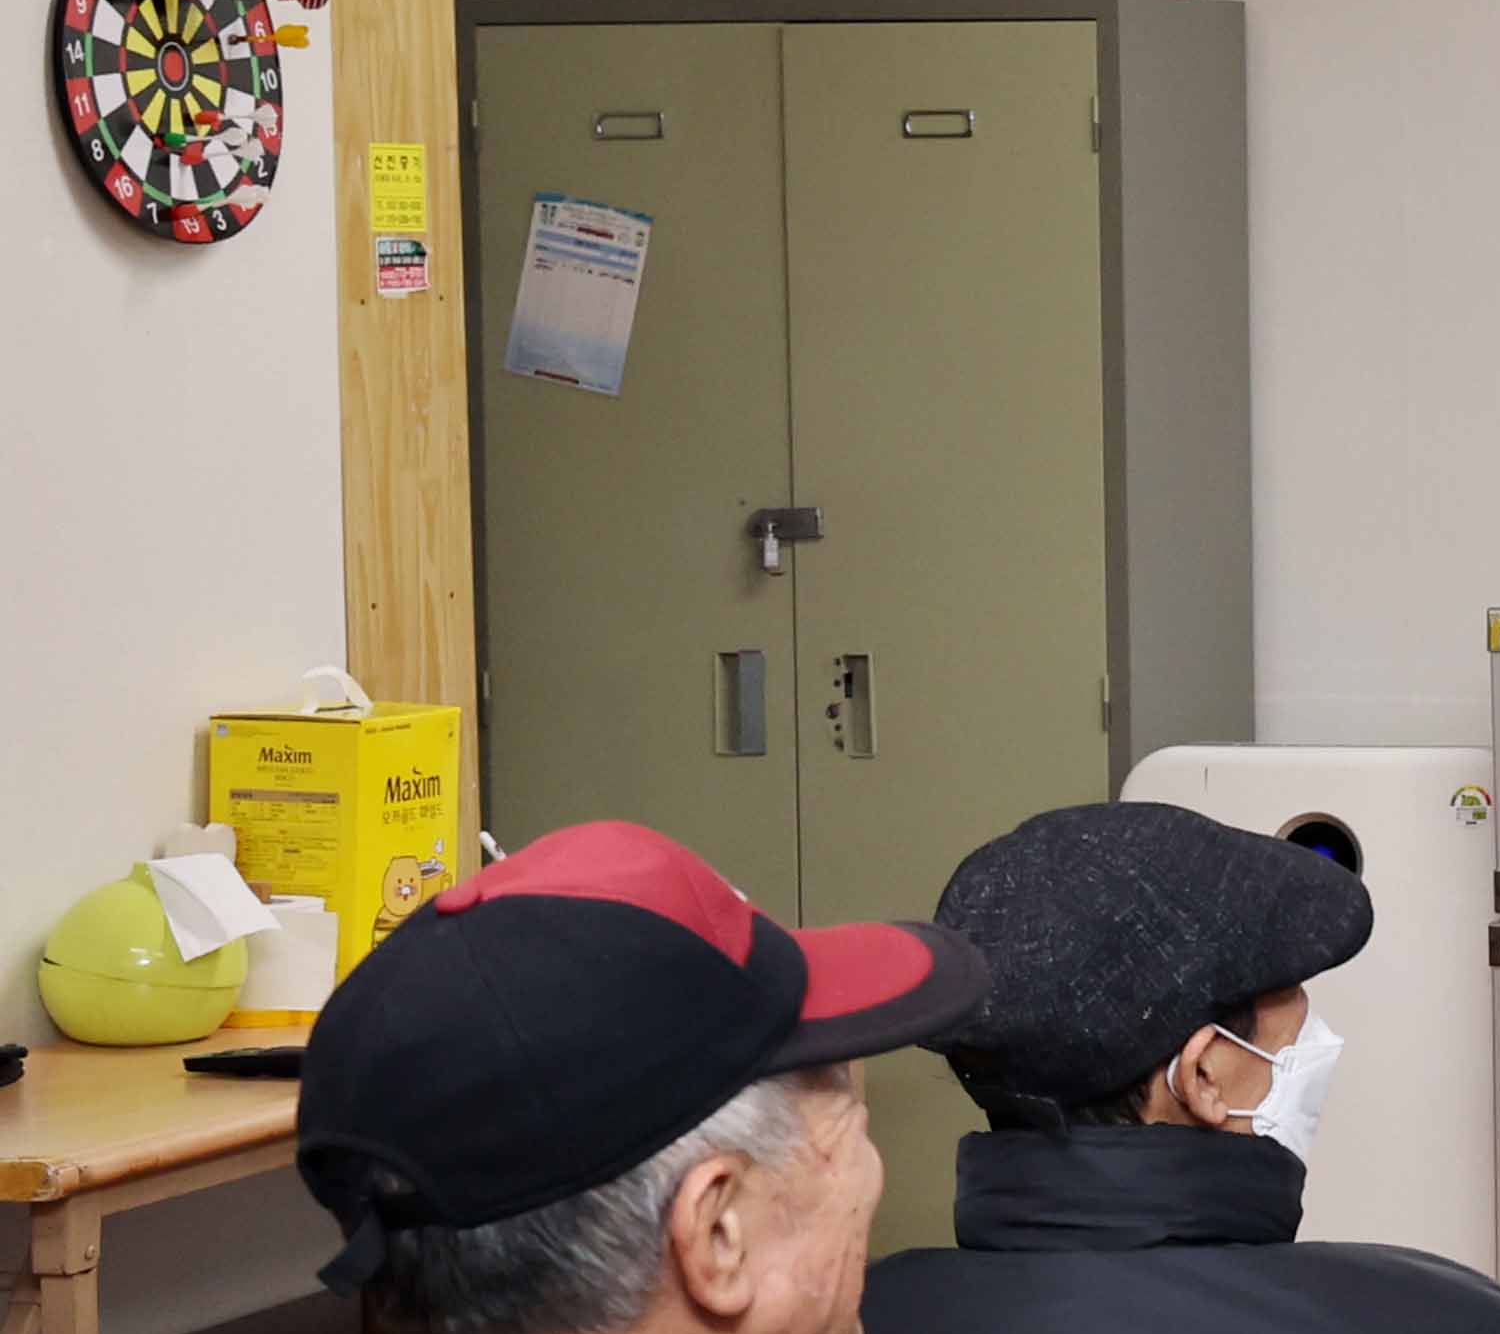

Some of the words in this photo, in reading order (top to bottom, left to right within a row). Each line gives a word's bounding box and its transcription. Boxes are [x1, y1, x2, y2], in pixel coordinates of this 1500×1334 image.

[65, 39, 84, 63] 14
[261, 68, 278, 91] 10
[74, 94, 90, 116] 11
[90, 138, 104, 161] 8
[255, 158, 267, 178] 2
[114, 176, 134, 200] 16
[147, 203, 159, 224] 7
[212, 210, 227, 231] 3
[258, 744, 312, 764] Maxim
[384, 767, 441, 804] Maxim
